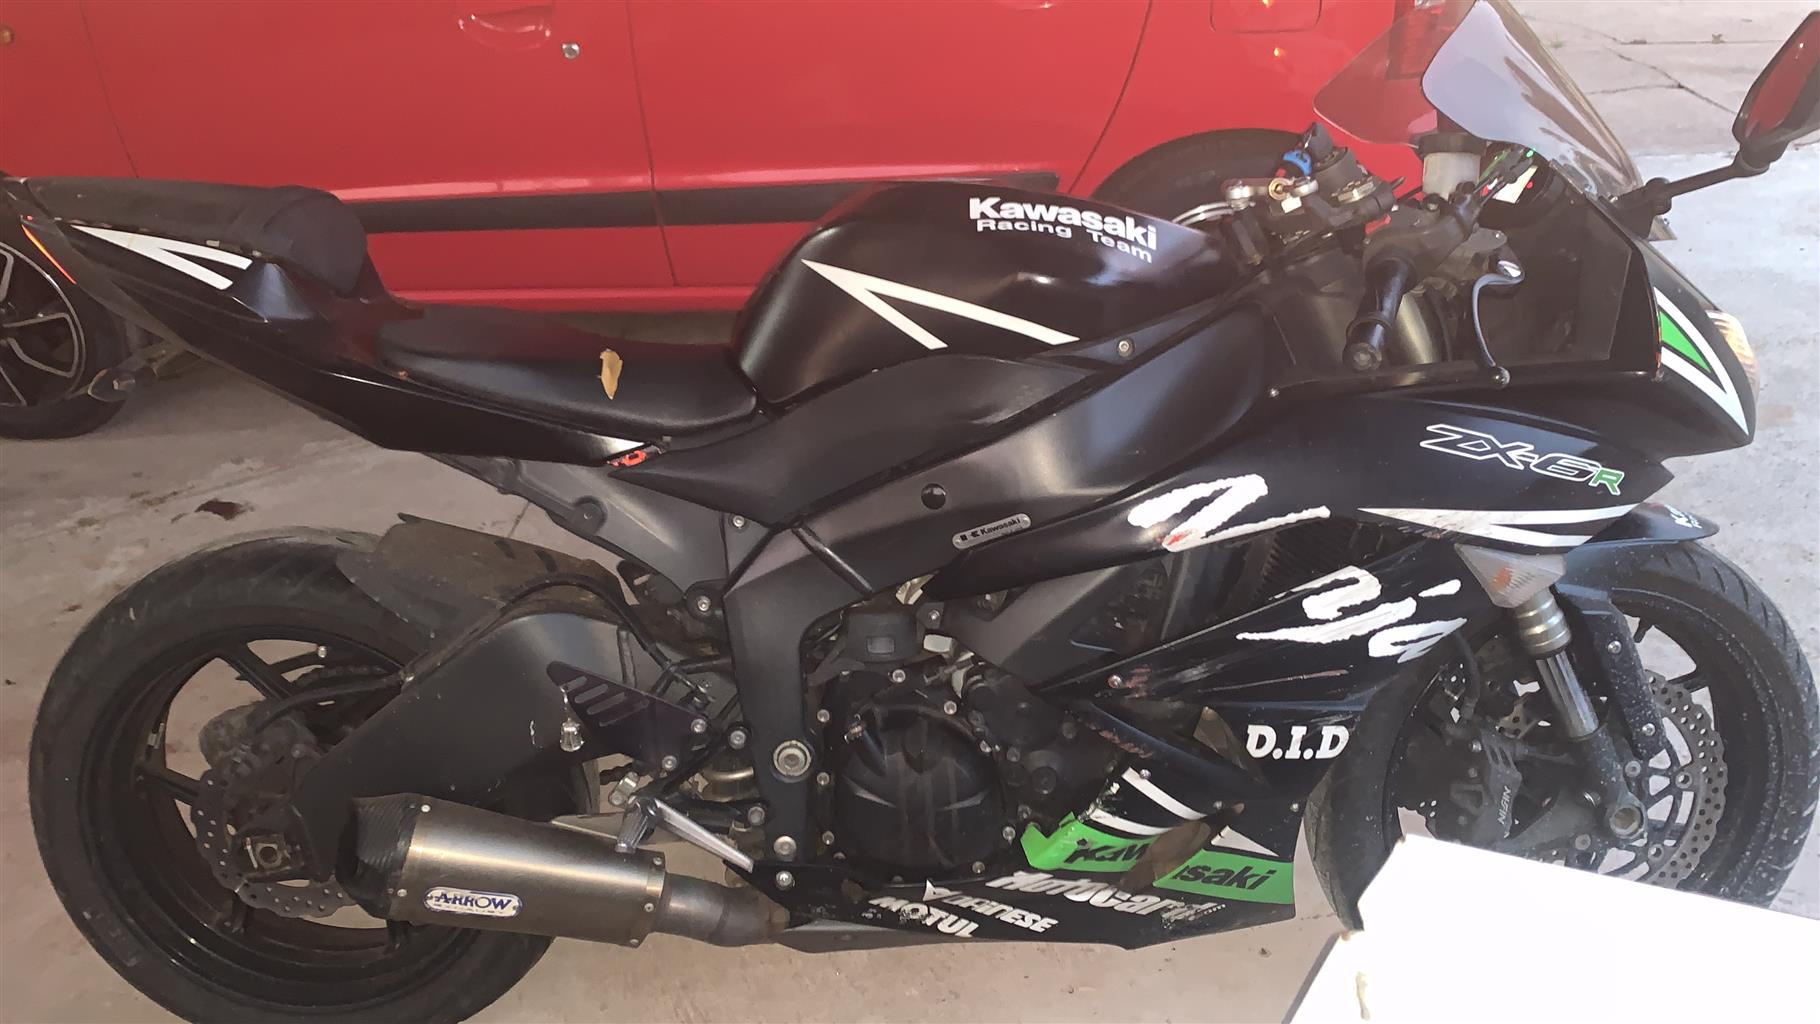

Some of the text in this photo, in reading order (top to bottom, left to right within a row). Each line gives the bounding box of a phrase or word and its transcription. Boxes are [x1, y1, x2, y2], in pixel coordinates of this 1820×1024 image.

[969, 196, 1157, 251] Kawasaki
[977, 218, 1152, 264] Racing Team
[1419, 423, 1625, 496] ZX-6R
[980, 518, 1021, 535] Kawasaki
[1246, 724, 1350, 760] D.I.D
[434, 892, 512, 911] ARROW
[868, 896, 979, 938] MOTUL
